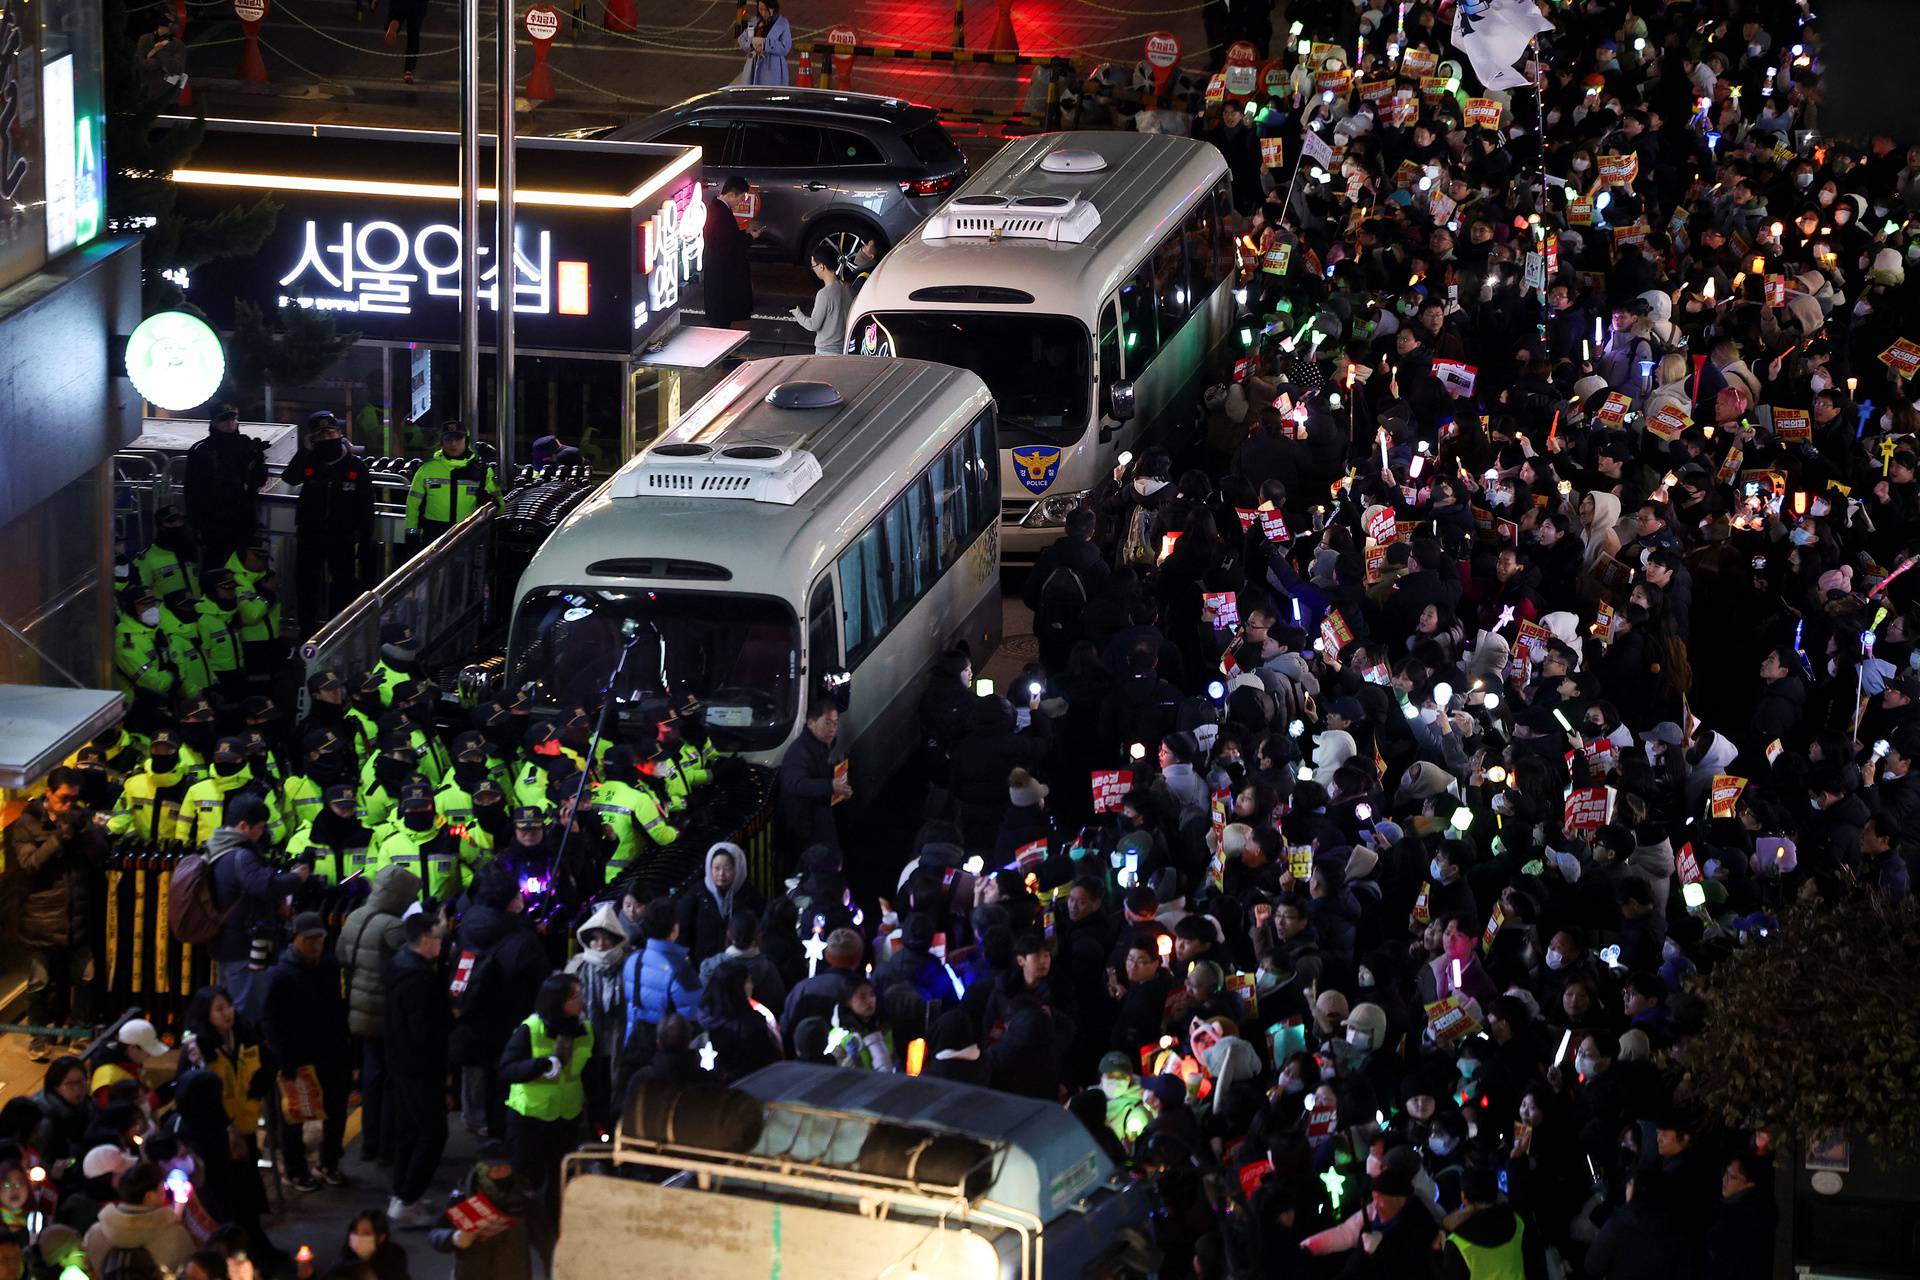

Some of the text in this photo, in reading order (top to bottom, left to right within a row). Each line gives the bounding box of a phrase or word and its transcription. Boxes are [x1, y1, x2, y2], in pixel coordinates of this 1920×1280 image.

[530, 14, 556, 25] 주차금지
[1777, 419, 1806, 429] 국민의힘
[305, 648, 313, 657] 7
